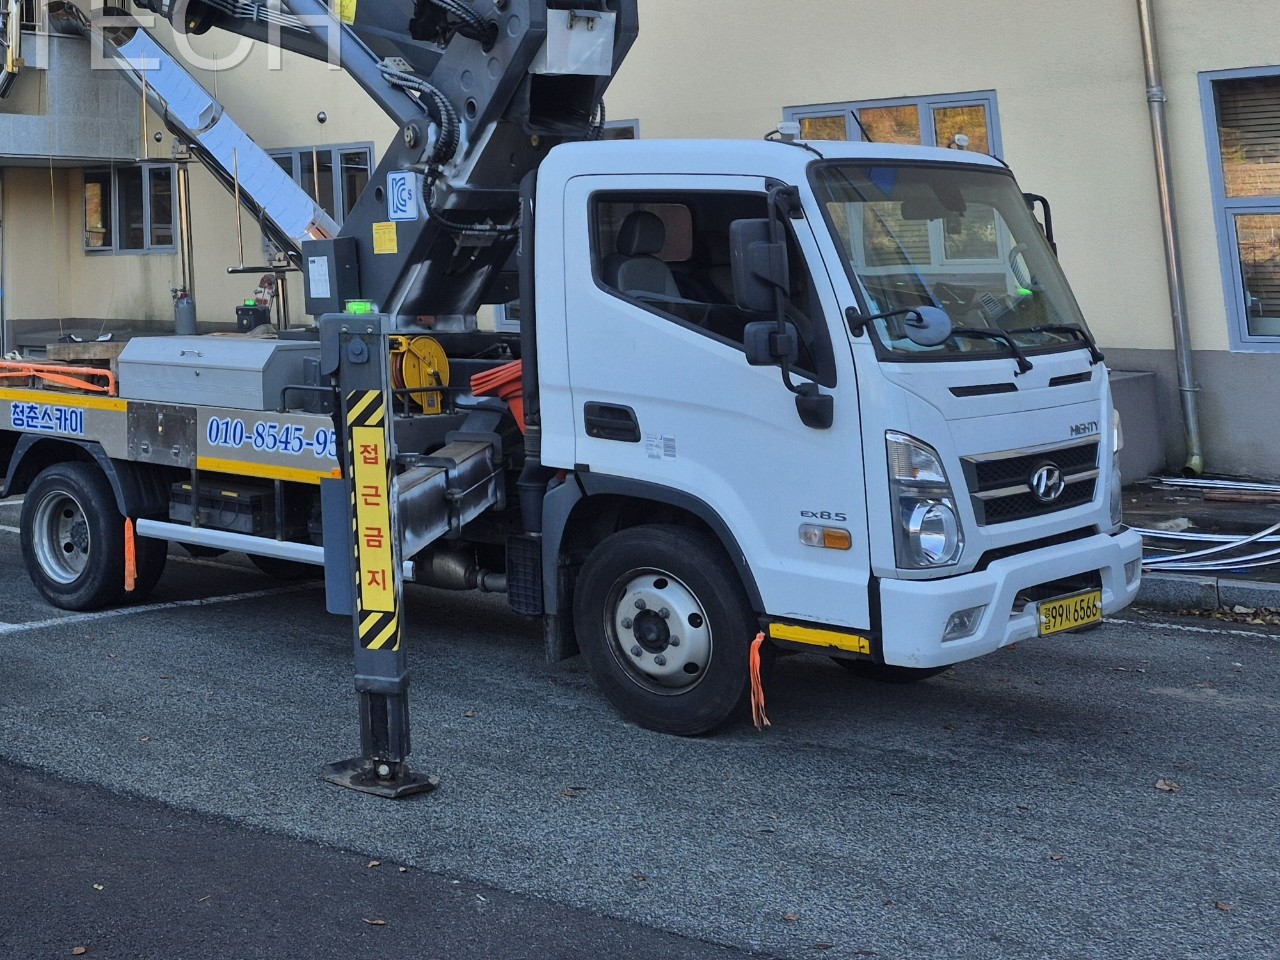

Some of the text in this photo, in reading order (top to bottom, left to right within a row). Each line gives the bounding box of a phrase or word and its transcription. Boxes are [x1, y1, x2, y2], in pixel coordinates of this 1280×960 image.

[10, 401, 85, 435] 청춘스카이
[1070, 420, 1099, 436] MIGHTY
[359, 444, 387, 591] 접근금지
[800, 509, 848, 522] EX8.5
